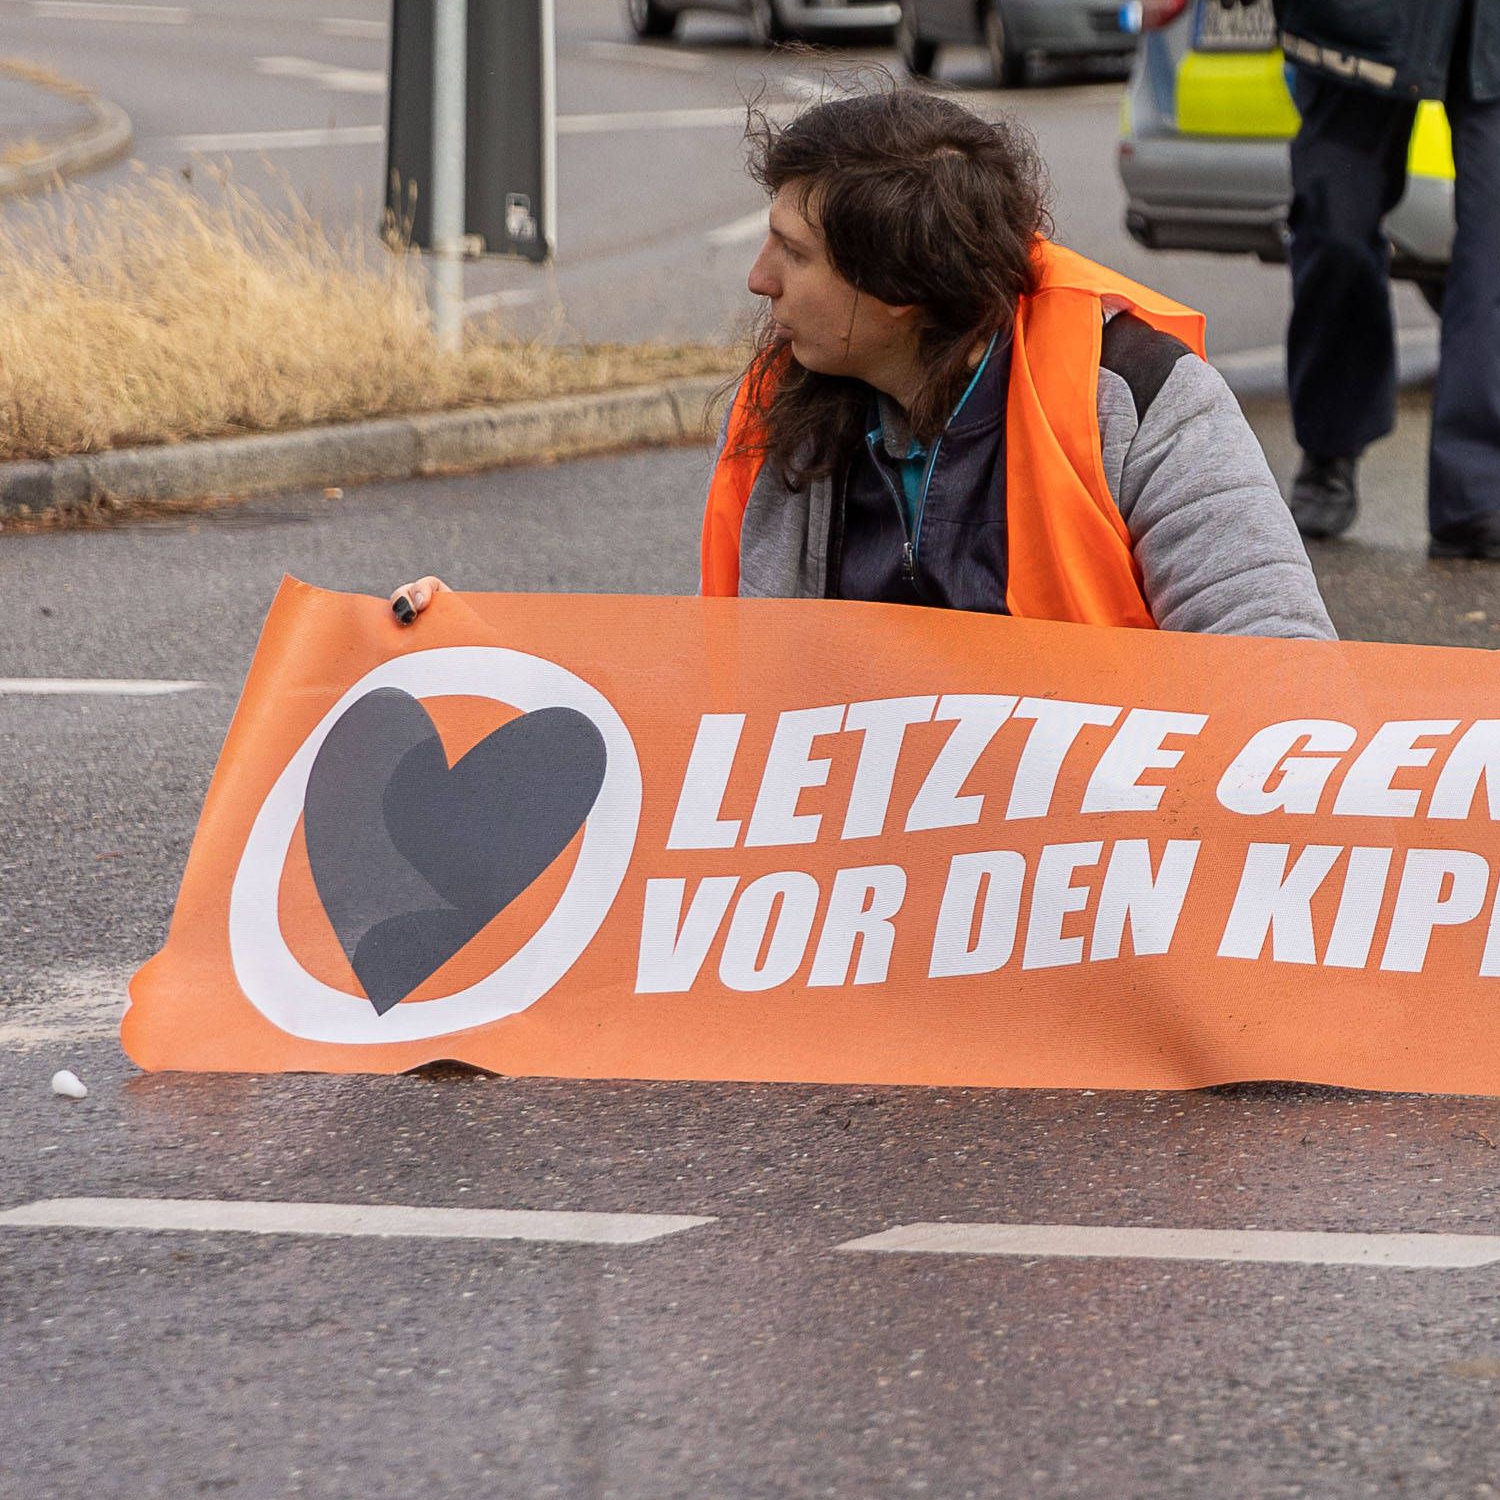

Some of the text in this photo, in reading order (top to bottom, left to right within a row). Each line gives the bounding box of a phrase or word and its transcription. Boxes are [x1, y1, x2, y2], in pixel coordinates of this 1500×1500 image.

[666, 694, 1209, 850] LETZTE
[634, 864, 907, 994] VOR
[929, 839, 1200, 979] DEN
